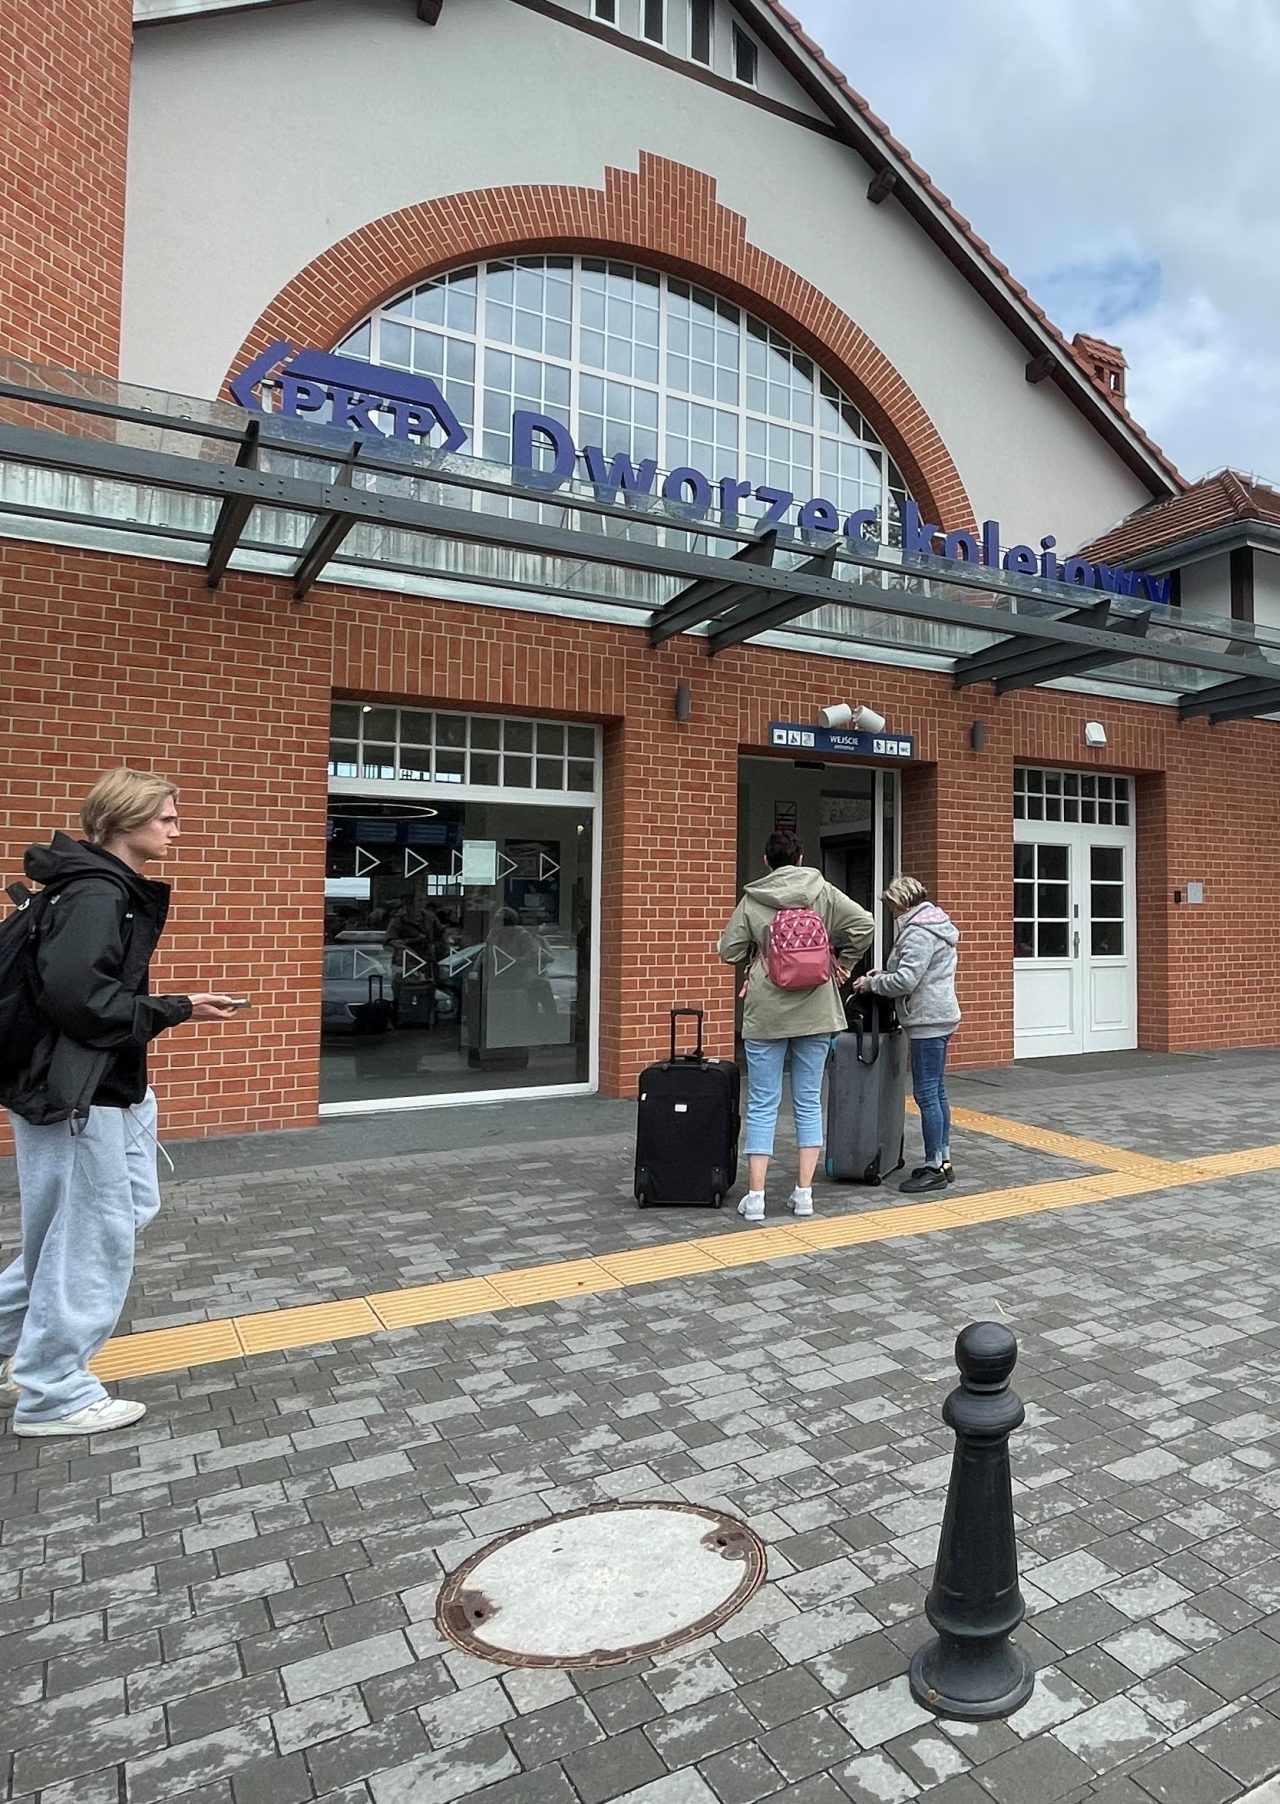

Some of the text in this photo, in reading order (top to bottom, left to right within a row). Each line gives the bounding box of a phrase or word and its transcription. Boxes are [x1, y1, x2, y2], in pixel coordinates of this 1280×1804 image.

[274, 373, 437, 447] PKP
[512, 410, 1172, 604] Dworzec kolejowy
[830, 735, 859, 745] WEJŚCIE
